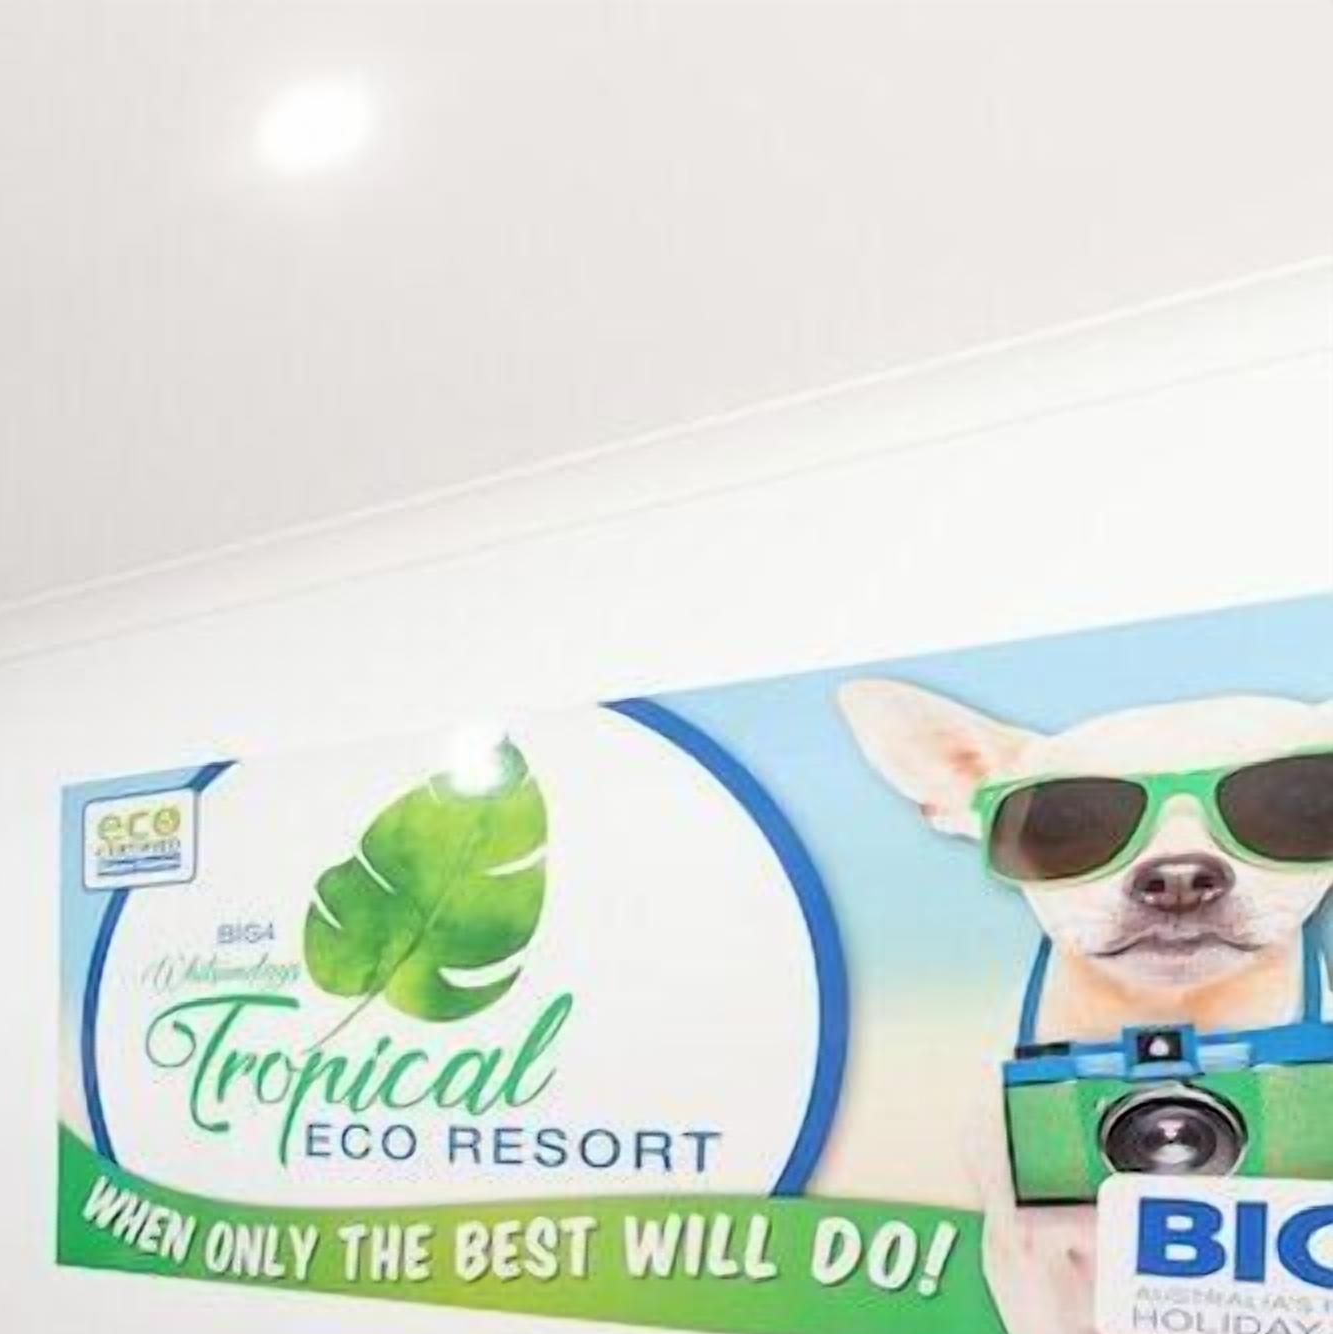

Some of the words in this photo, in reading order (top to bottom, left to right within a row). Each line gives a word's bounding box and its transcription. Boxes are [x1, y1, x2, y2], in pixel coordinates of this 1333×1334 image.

[145, 992, 574, 1167] Tropical
[304, 1123, 418, 1161] ECO
[447, 1126, 723, 1174] RESORT
[81, 1174, 197, 1263] WHEN
[204, 1221, 319, 1282] ONLY
[338, 1223, 435, 1283] THE
[454, 1215, 597, 1282] BEST
[624, 1212, 779, 1280] WILL
[810, 1215, 960, 1296] DO!
